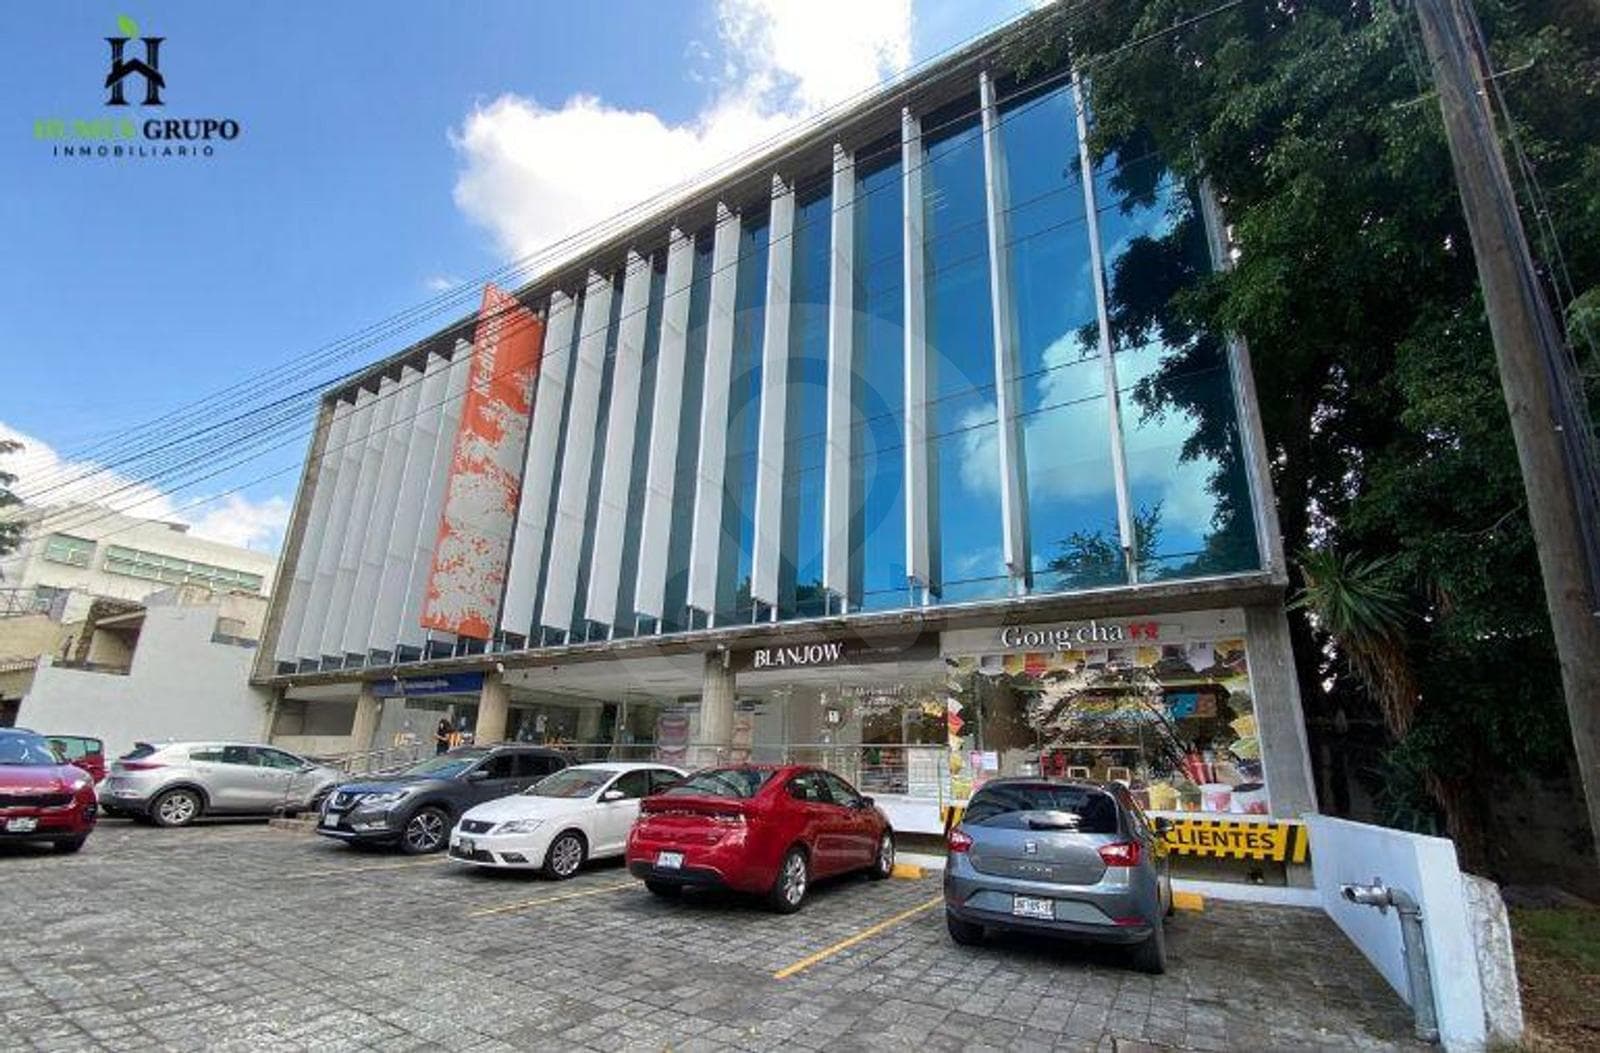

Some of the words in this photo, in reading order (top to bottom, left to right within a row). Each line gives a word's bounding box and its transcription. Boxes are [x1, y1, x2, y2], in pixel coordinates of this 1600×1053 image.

[1001, 625, 1072, 651] Gong
[1076, 620, 1123, 643] cha
[754, 642, 844, 668] BLANJOW
[1162, 829, 1275, 850] CLIENTES
